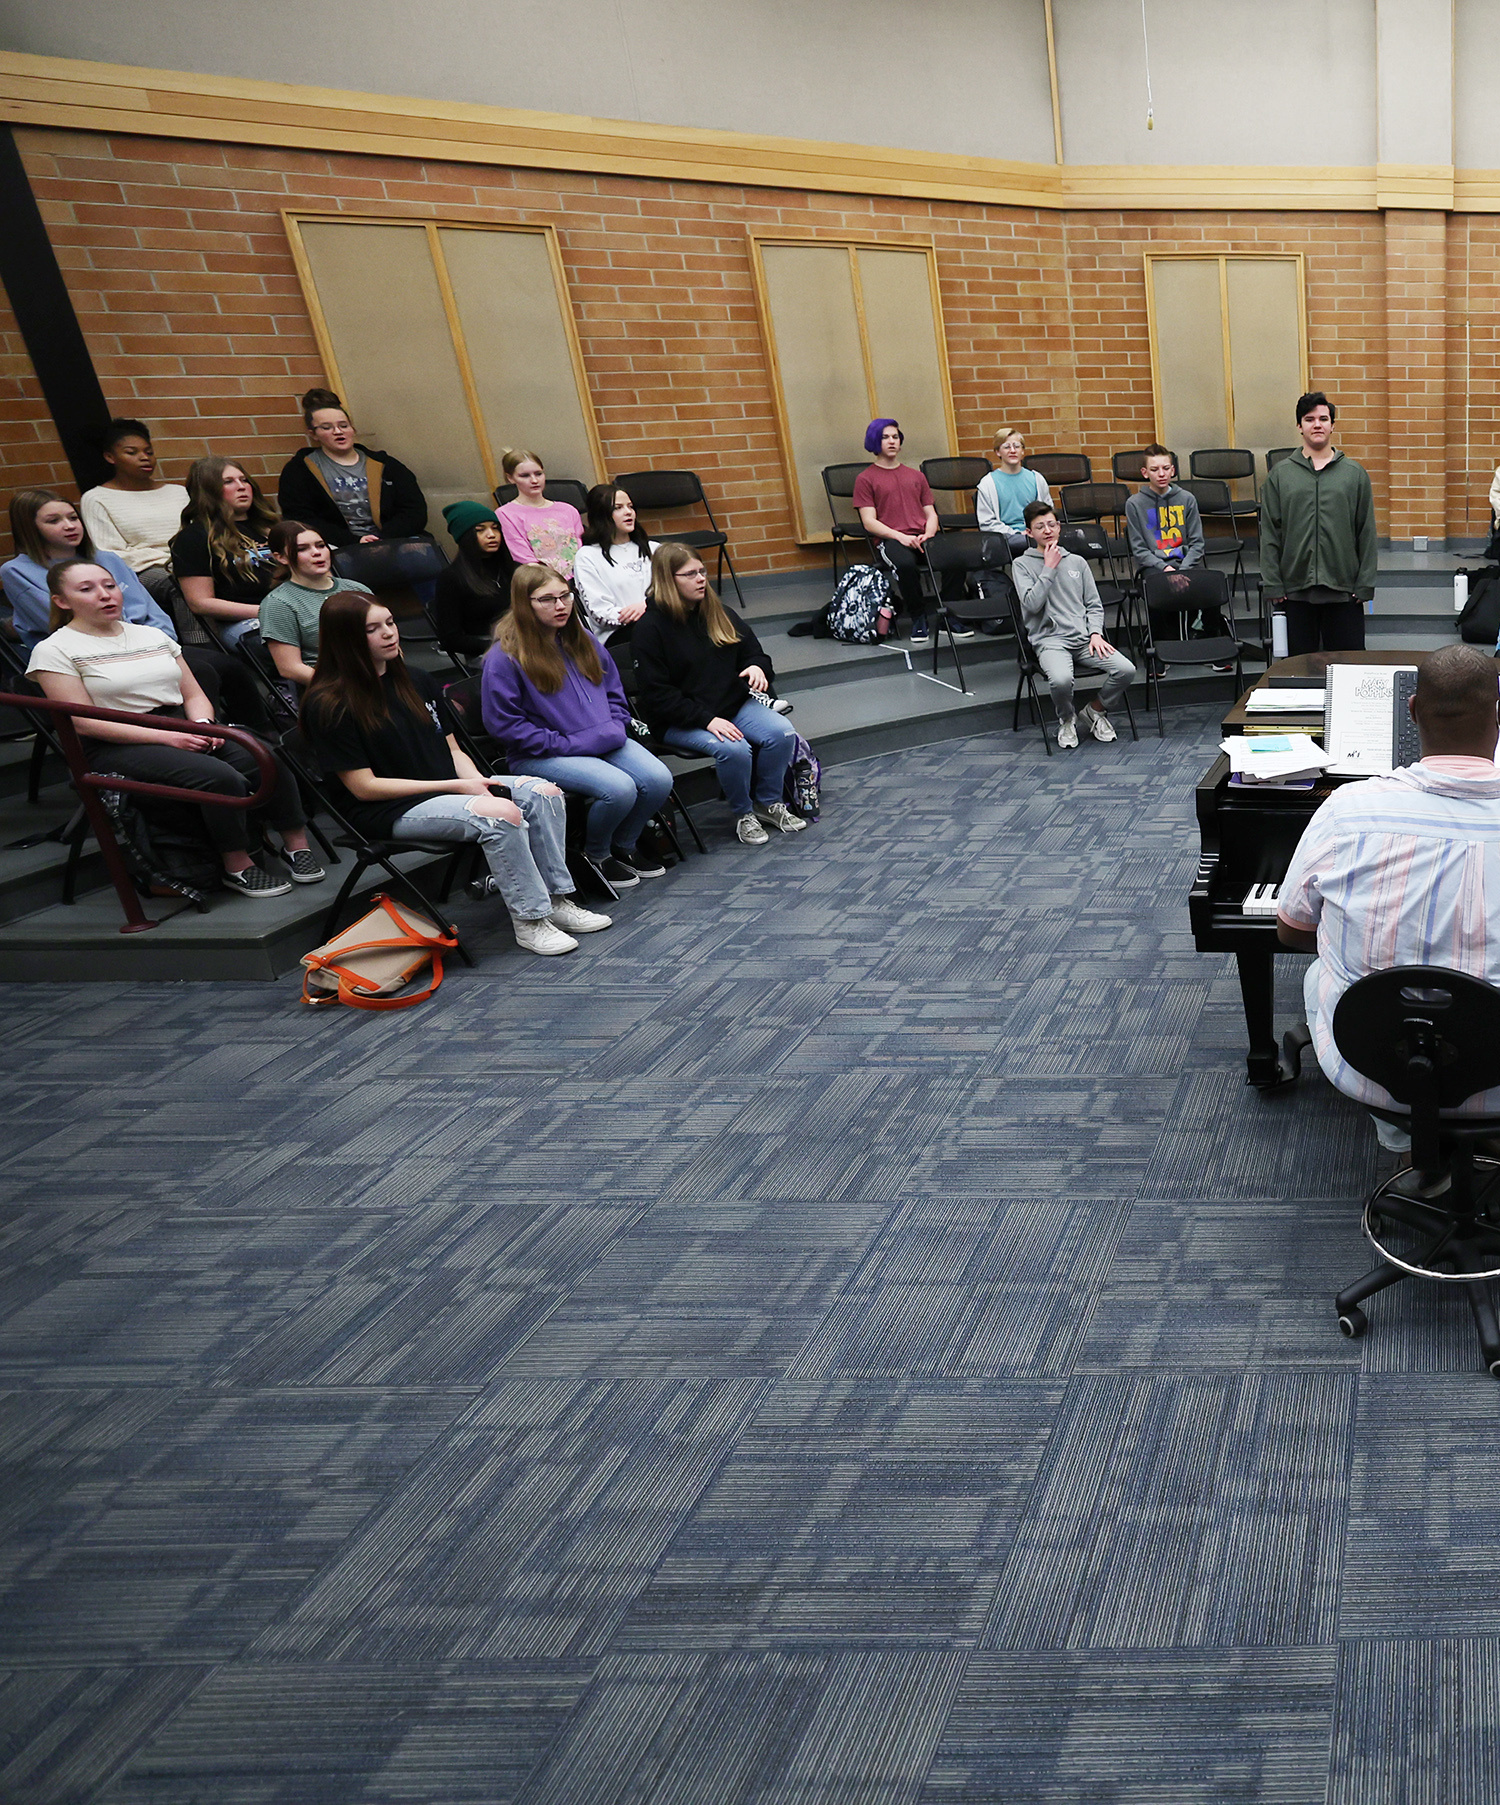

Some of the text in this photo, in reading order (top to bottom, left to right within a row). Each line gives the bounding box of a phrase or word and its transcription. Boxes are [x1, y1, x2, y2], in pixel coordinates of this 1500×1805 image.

[1146, 505, 1185, 529] JUST
[1154, 527, 1183, 550] DO
[1354, 686, 1393, 698] POPPINS
[1361, 678, 1390, 690] MARY
